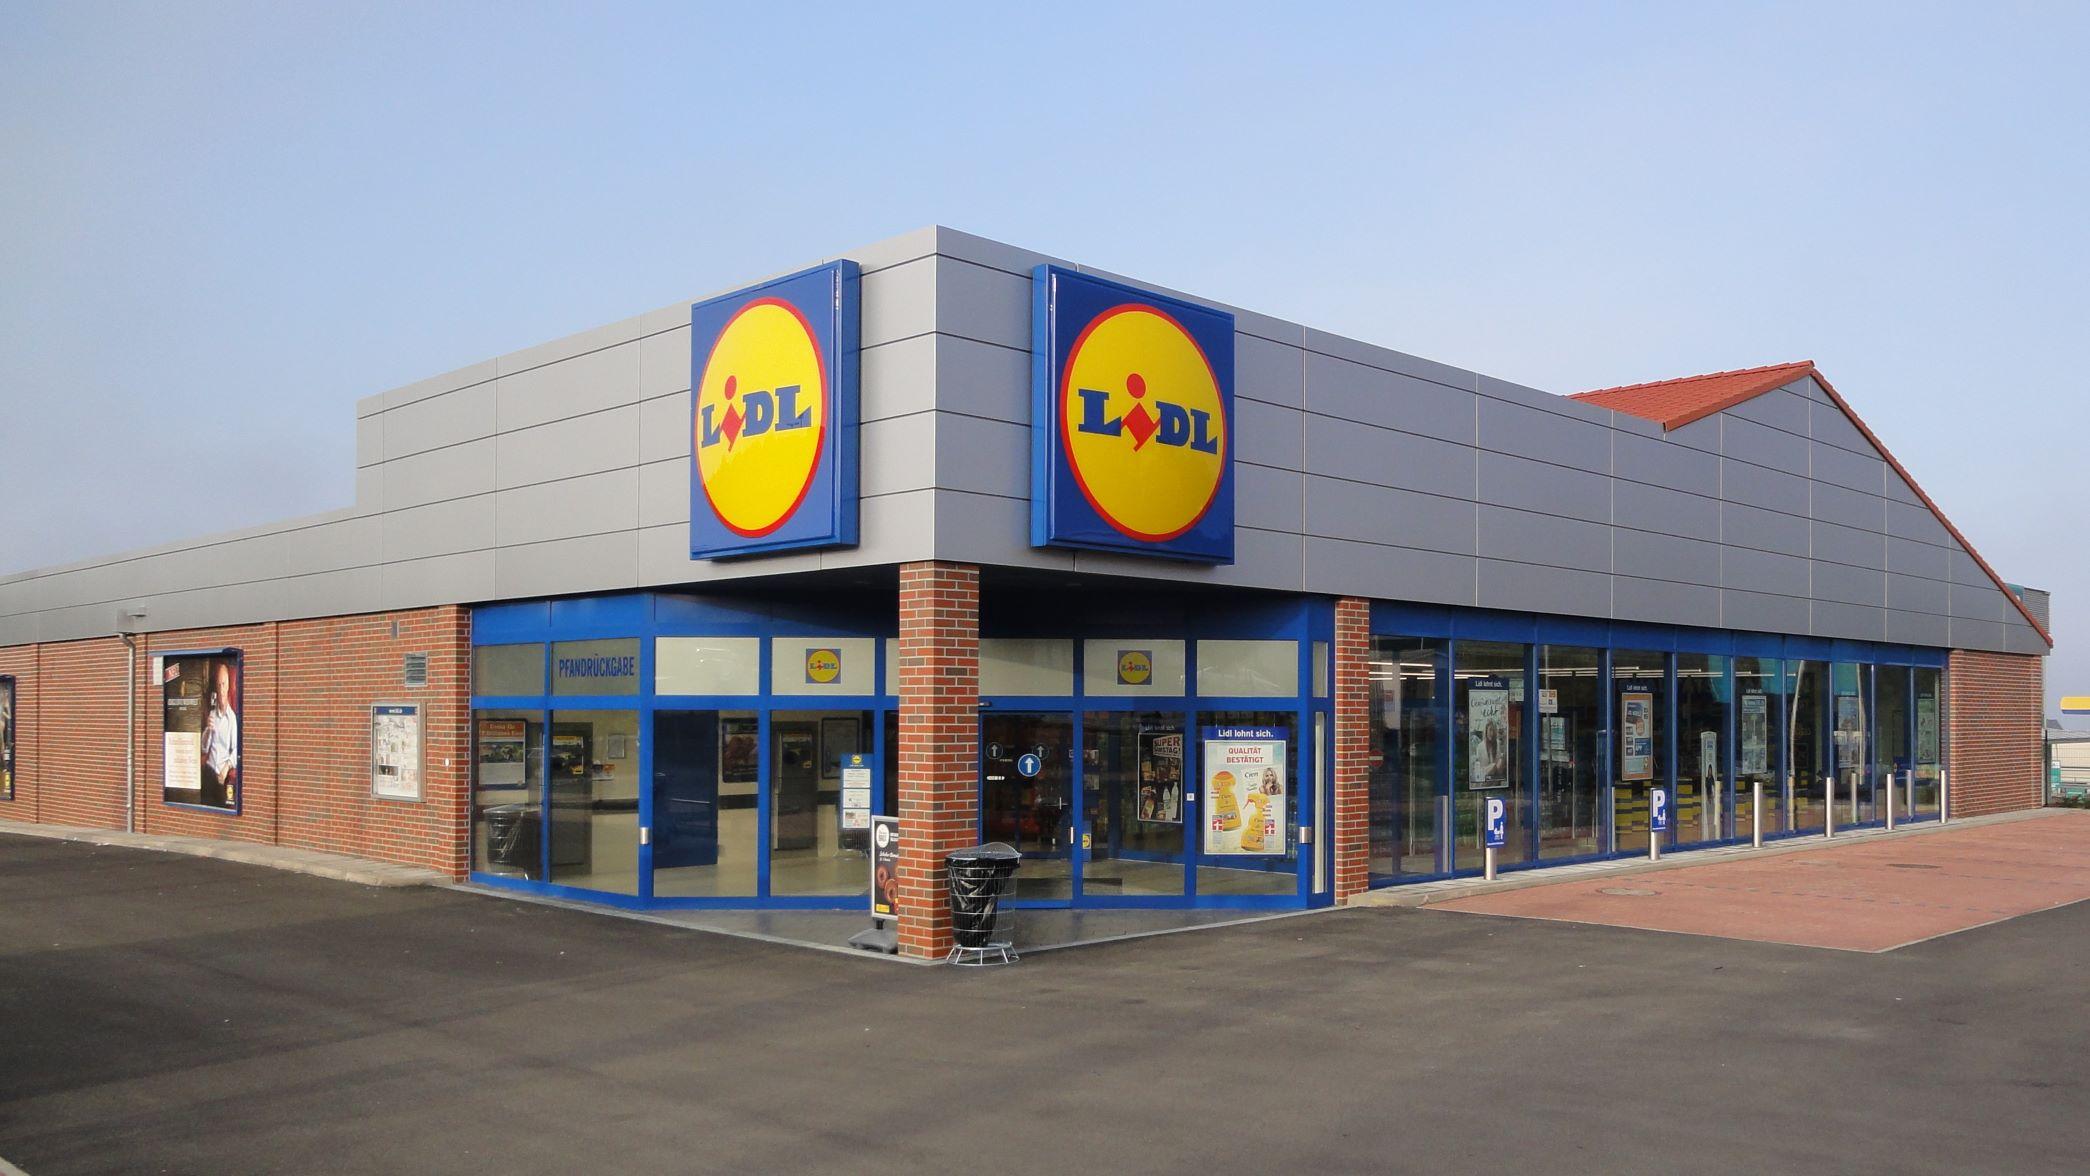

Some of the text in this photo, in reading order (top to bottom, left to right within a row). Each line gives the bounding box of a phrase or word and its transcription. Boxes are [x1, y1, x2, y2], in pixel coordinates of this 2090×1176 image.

[559, 653, 635, 678] PFANDRÜCKGABE
[1218, 729, 1274, 738] Lidl lohnt sich.
[1226, 754, 1264, 764] BESTÄTIGT
[1228, 746, 1262, 755] QUALITÄT
[1652, 790, 1665, 817] P
[1487, 799, 1503, 831] P
